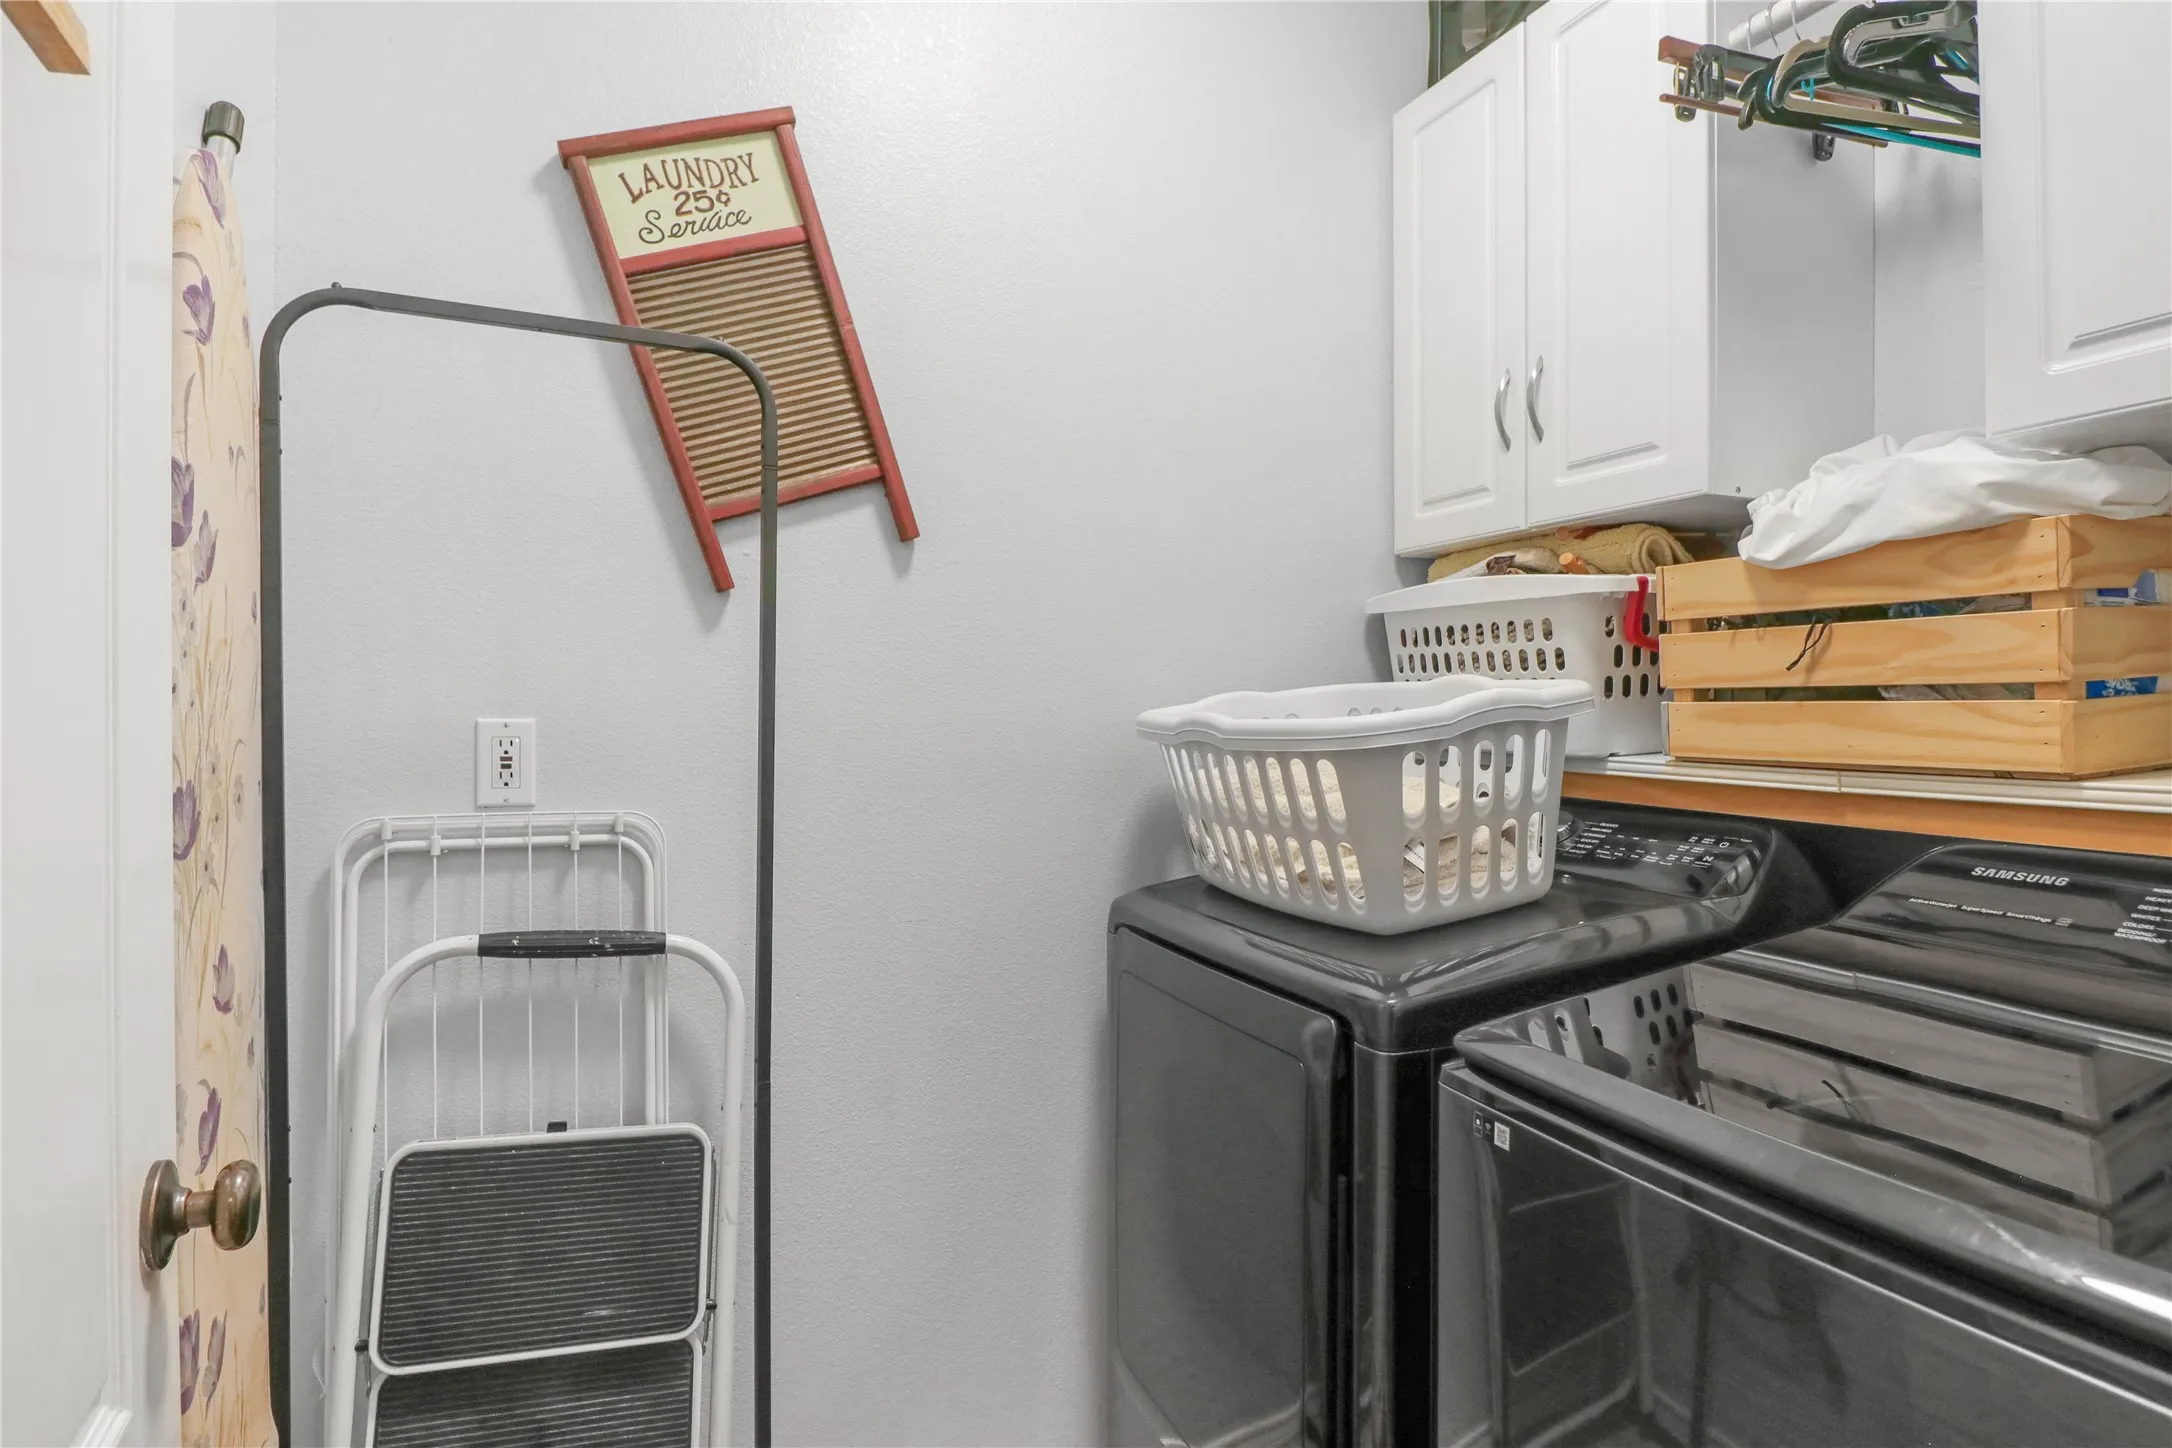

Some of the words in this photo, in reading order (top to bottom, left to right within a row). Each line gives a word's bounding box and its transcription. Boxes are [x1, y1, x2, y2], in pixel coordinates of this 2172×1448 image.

[617, 152, 760, 205] LAUNDRY
[673, 189, 732, 218] 25¢
[638, 209, 753, 244] Service
[1970, 866, 2070, 886] SAMSUNG
